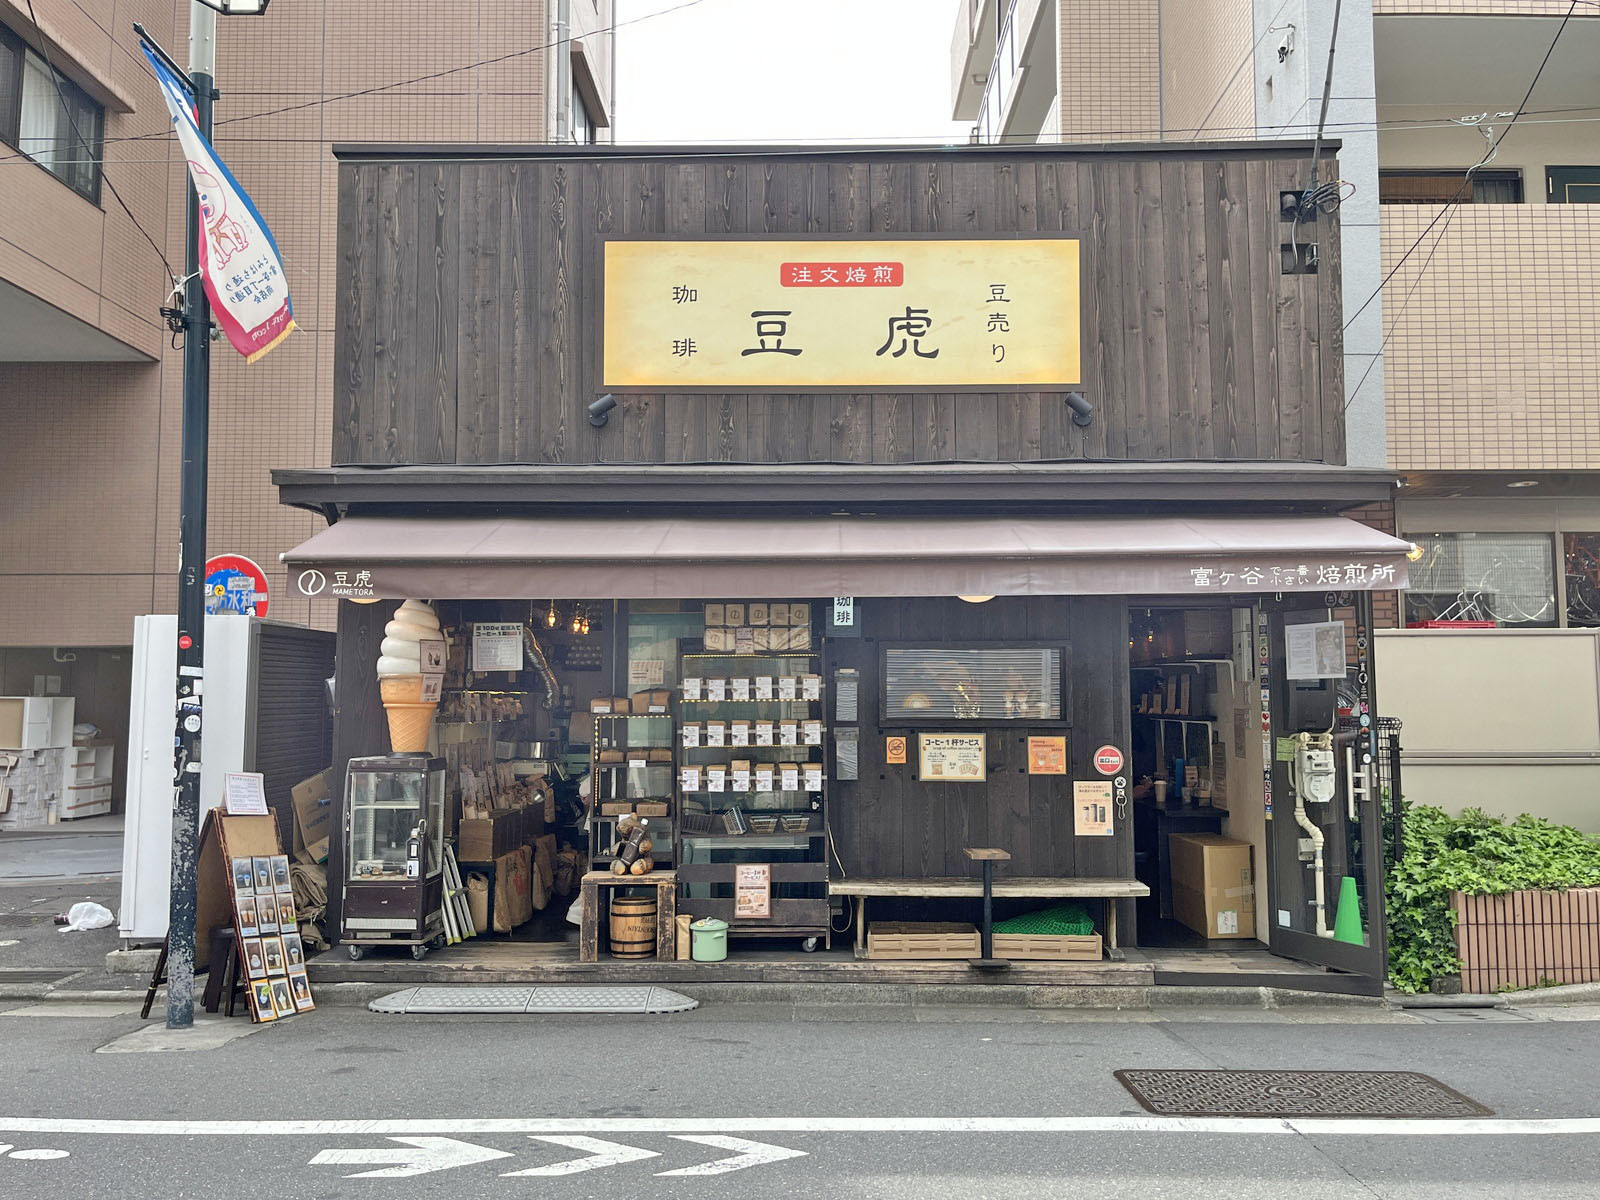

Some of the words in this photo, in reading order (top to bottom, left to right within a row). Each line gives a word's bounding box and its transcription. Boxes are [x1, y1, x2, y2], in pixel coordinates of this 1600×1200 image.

[792, 265, 893, 284] 注文焙煎
[672, 285, 698, 358] 珈琲
[741, 305, 940, 360] 豆虎
[985, 284, 1011, 363] 豆売り
[332, 569, 374, 588] 豆虎
[1316, 563, 1396, 585] 焙煎所
[332, 588, 374, 596] MAMETORA
[836, 596, 850, 623] 珈琲
